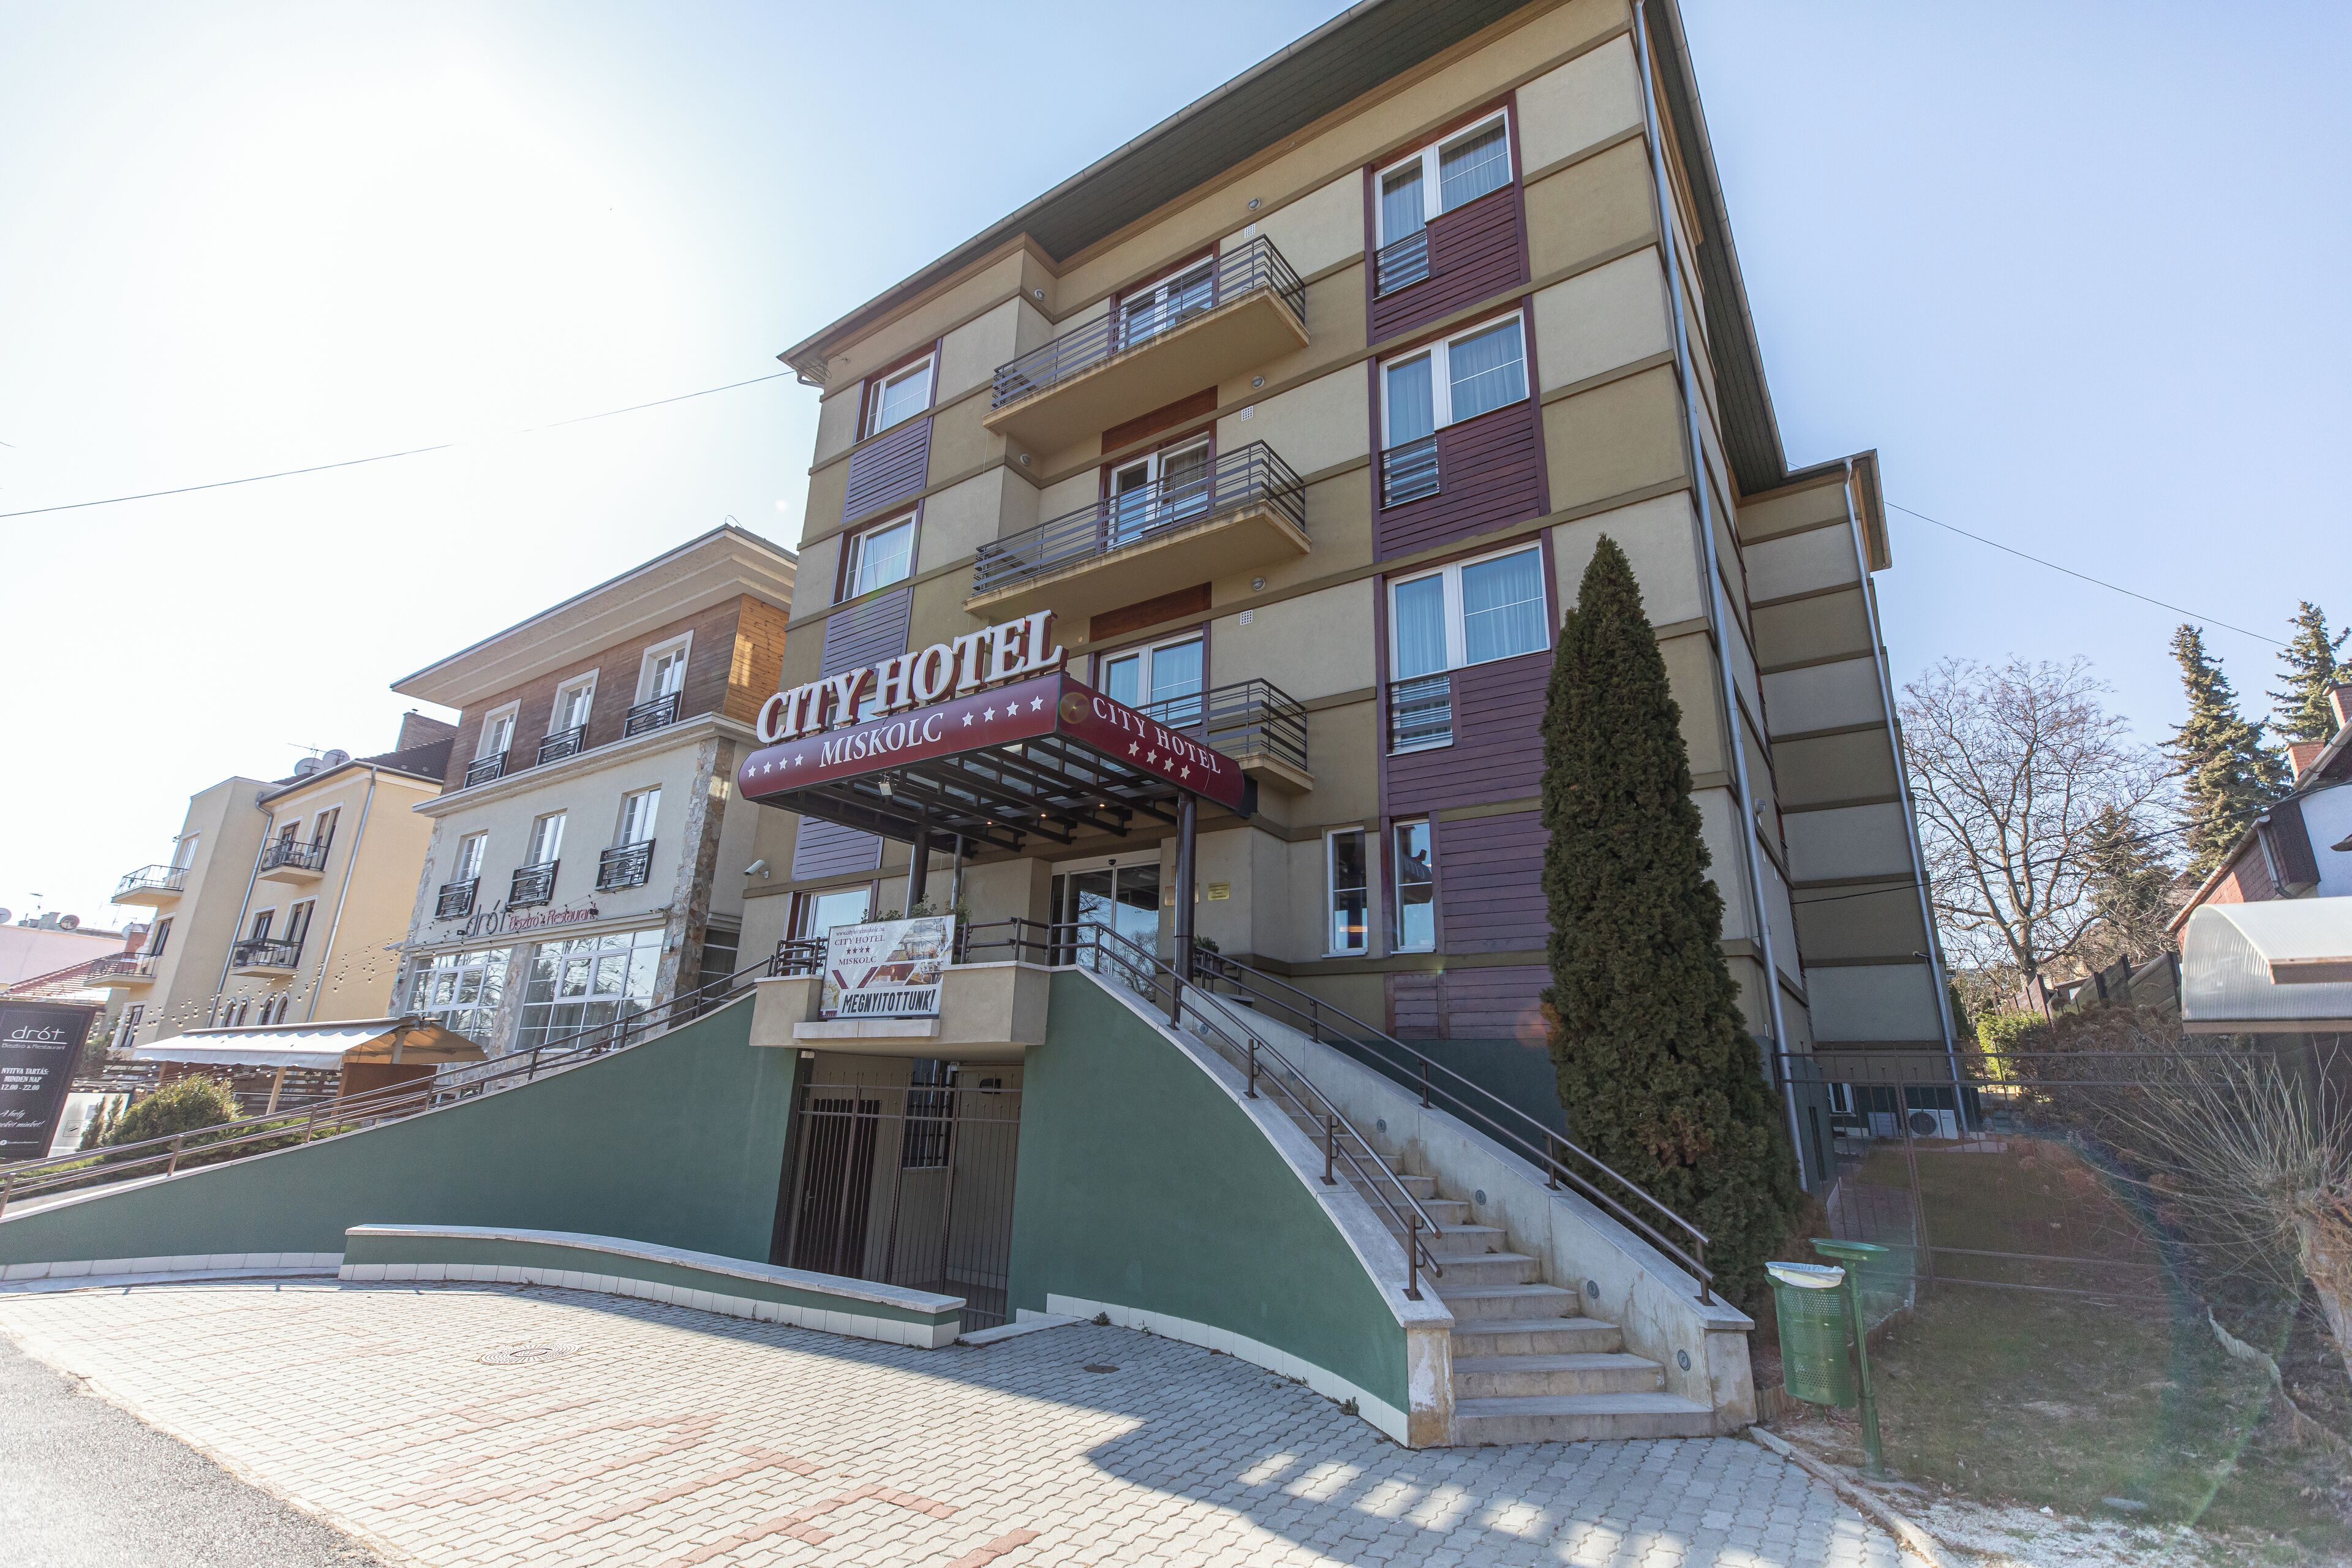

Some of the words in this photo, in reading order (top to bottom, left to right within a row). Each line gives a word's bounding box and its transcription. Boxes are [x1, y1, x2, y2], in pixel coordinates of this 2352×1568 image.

[756, 667, 872, 744] CITY
[870, 609, 1066, 715] HOTEL
[819, 712, 944, 768] MISKOLC
[1093, 697, 1145, 738] CITY
[1154, 726, 1221, 774] HOTEL
[834, 937, 854, 946] CITY
[855, 935, 885, 944] HOTEL
[839, 956, 876, 966] MISKOLC
[841, 989, 937, 1014] MEGNYITOTTUNK!
[12, 1025, 66, 1041] drót
